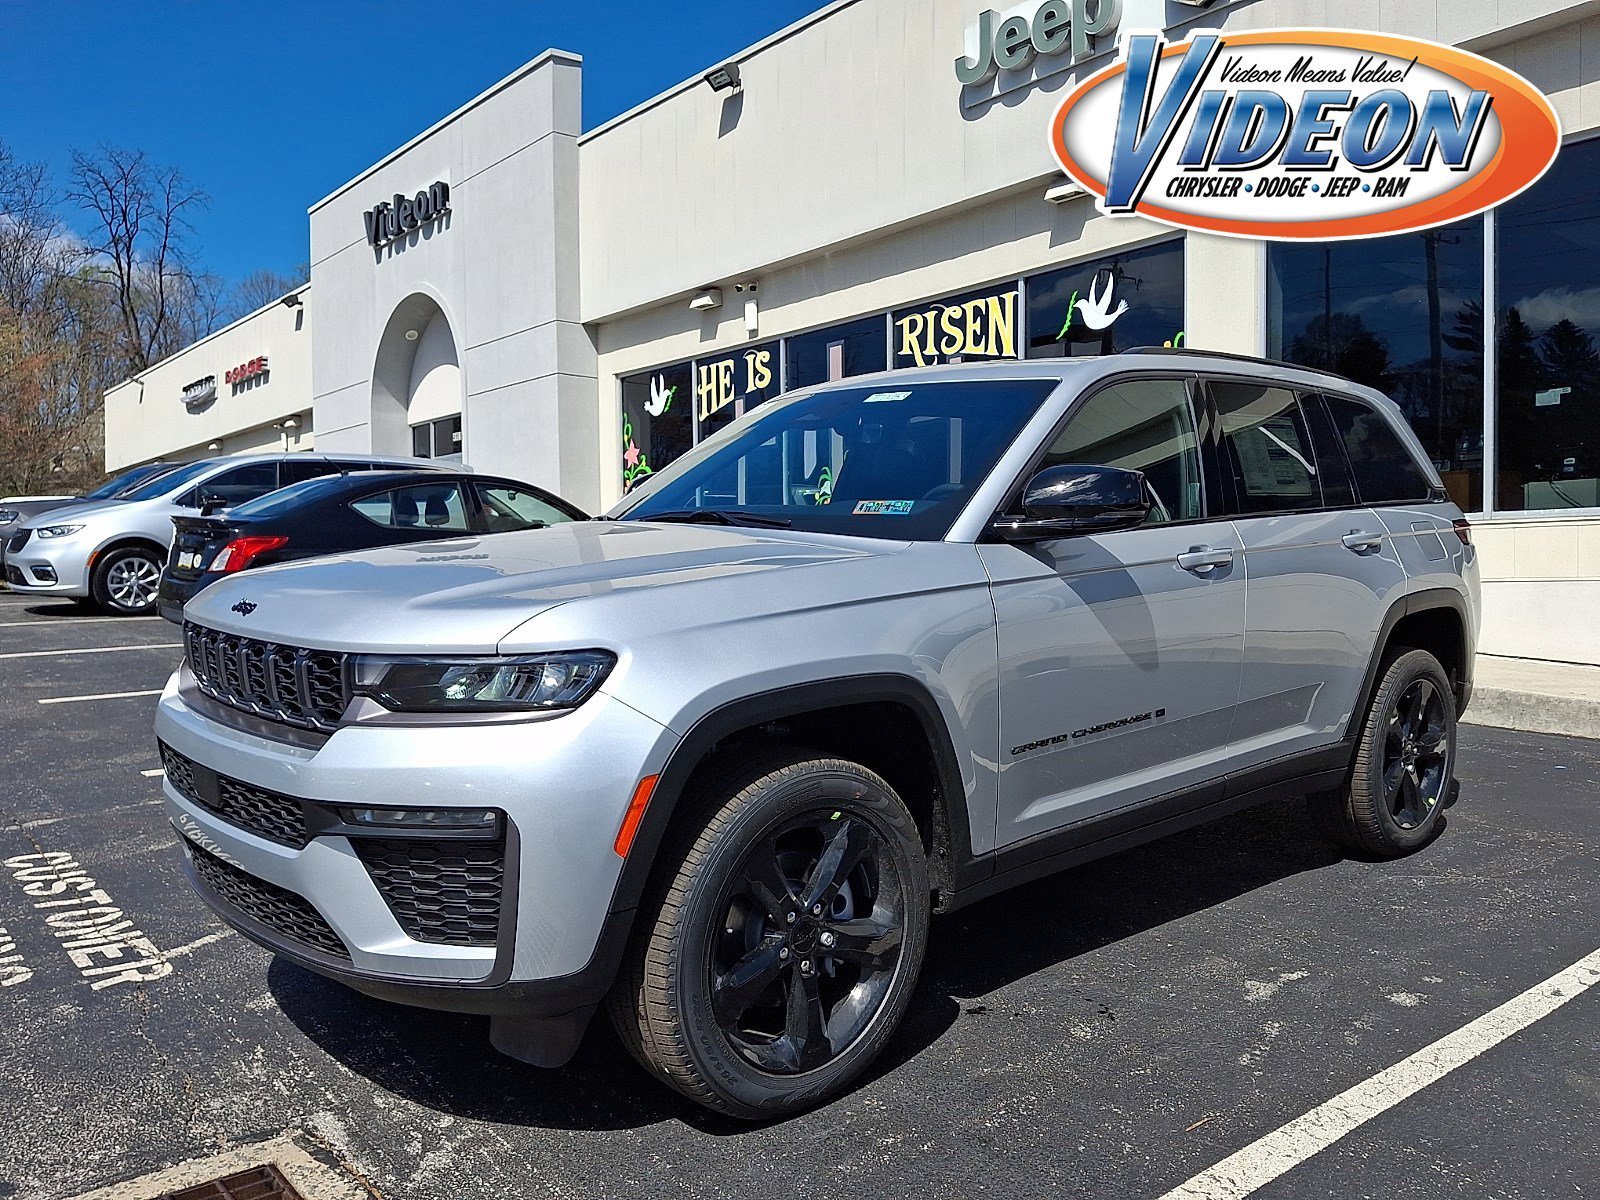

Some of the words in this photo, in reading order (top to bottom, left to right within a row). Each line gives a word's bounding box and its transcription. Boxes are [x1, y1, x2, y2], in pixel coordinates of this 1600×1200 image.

[954, 0, 1119, 85] Jeep
[363, 181, 450, 246] Videon
[895, 290, 1019, 367] RISEN
[698, 359, 735, 422] HE
[743, 349, 772, 394] IS
[1011, 733, 1068, 755] GRAND
[1071, 711, 1152, 739] CHEROKEE
[3, 851, 174, 991] CUSTOMER
